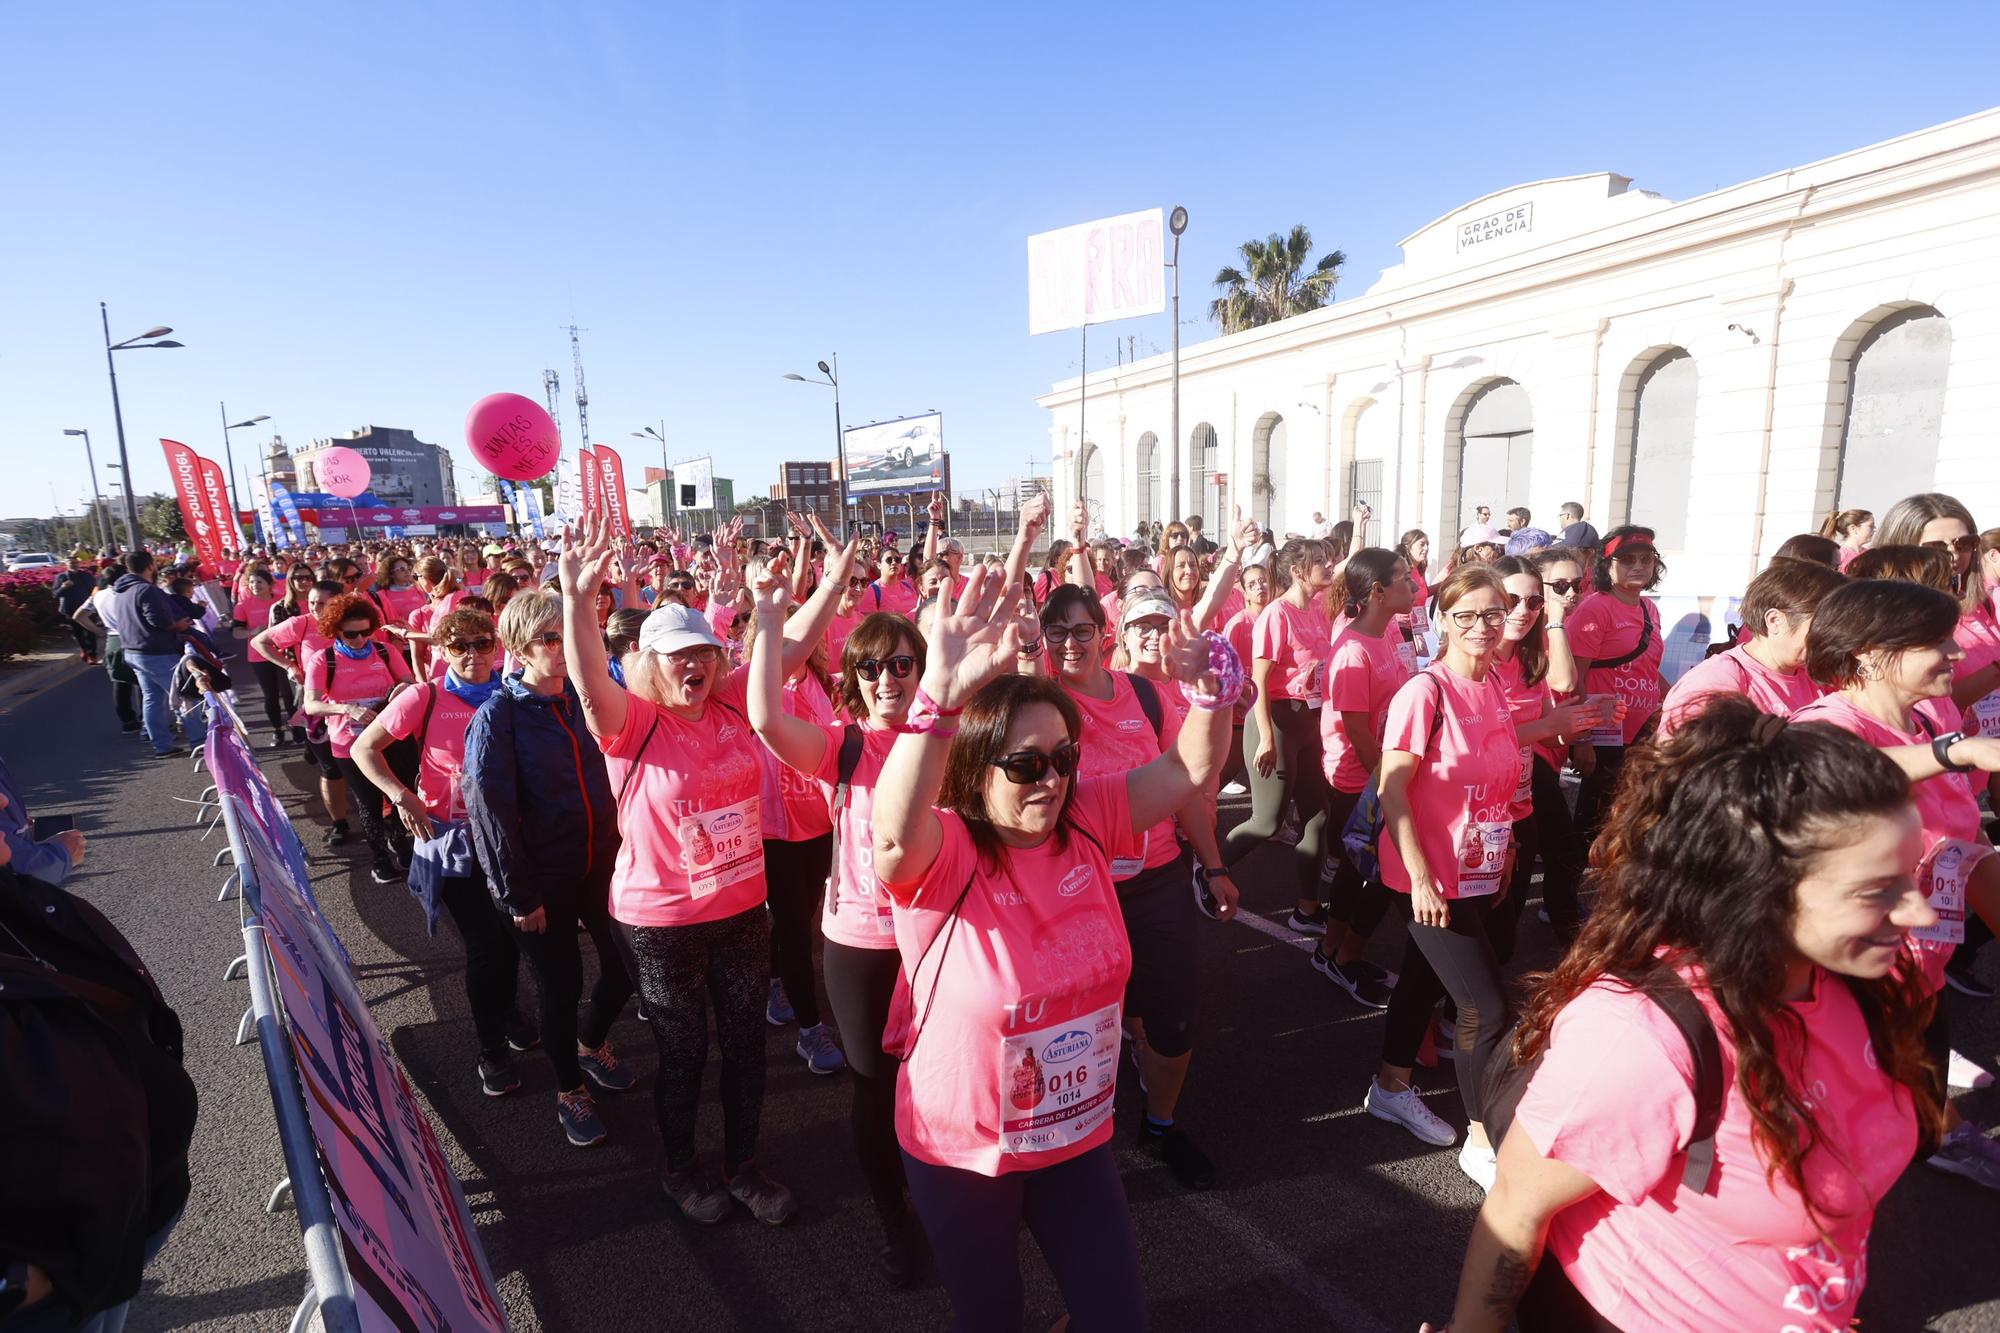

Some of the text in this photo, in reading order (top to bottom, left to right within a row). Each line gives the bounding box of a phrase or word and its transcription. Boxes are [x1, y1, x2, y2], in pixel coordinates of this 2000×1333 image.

[1464, 208, 1525, 236] GRAO DE
[1461, 219, 1526, 248] VALENCIA
[483, 415, 532, 459] JUNTAS
[512, 435, 532, 453] ES
[1615, 677, 1660, 692] DORSA
[1464, 783, 1488, 803] TU
[674, 799, 702, 817] TU
[717, 835, 742, 853] 016
[725, 851, 736, 860] 151
[1003, 998, 1048, 1029] TU
[1046, 1039, 1089, 1061] ASTURIANA
[1049, 1065, 1088, 1093] 016
[1057, 1089, 1081, 1106] 1014
[1013, 1104, 1109, 1145] OYSHO Santander
[1018, 1115, 1054, 1129] CARRERA
[1055, 1111, 1066, 1120] DE
[1067, 1109, 1077, 1117] LA
[1077, 1098, 1098, 1114] MUJER
